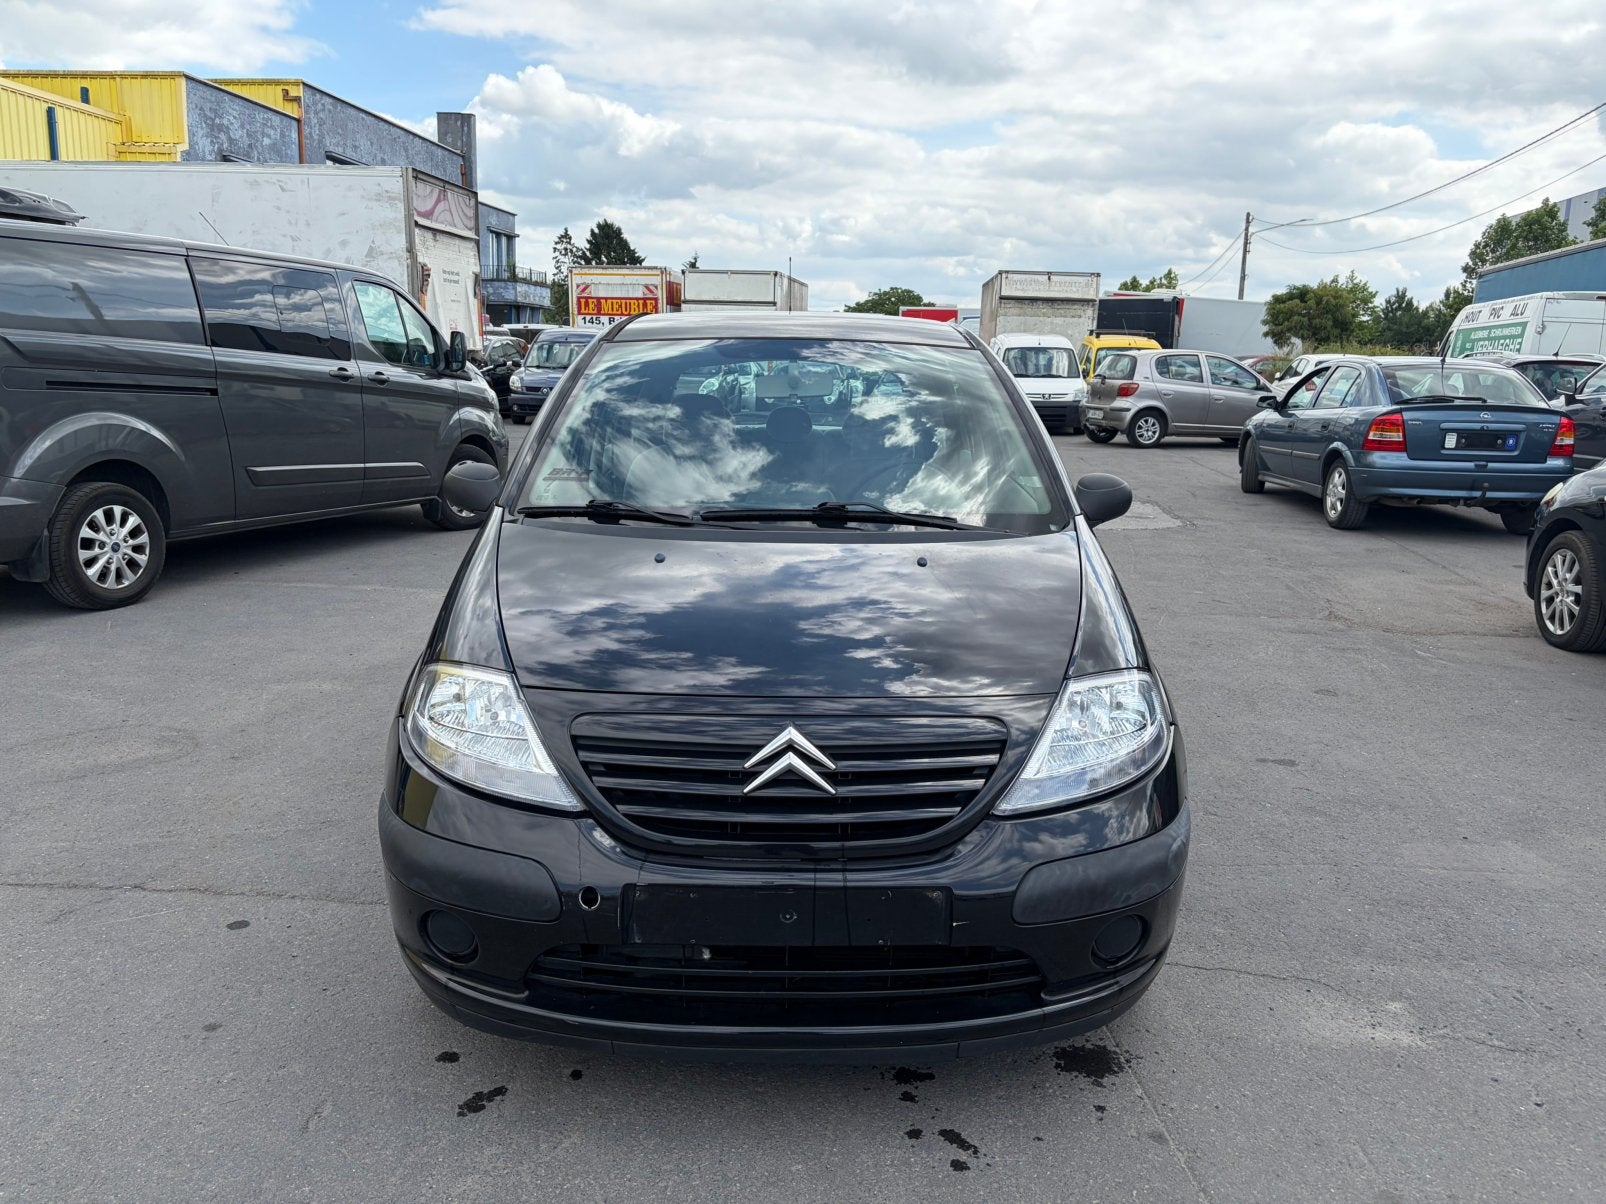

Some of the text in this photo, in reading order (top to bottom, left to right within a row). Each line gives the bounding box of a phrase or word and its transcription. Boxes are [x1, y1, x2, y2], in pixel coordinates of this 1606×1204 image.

[580, 299, 656, 314] LE MEUBLE
[1463, 302, 1529, 324] HOUT PVC ALU
[581, 316, 605, 326] 145,
